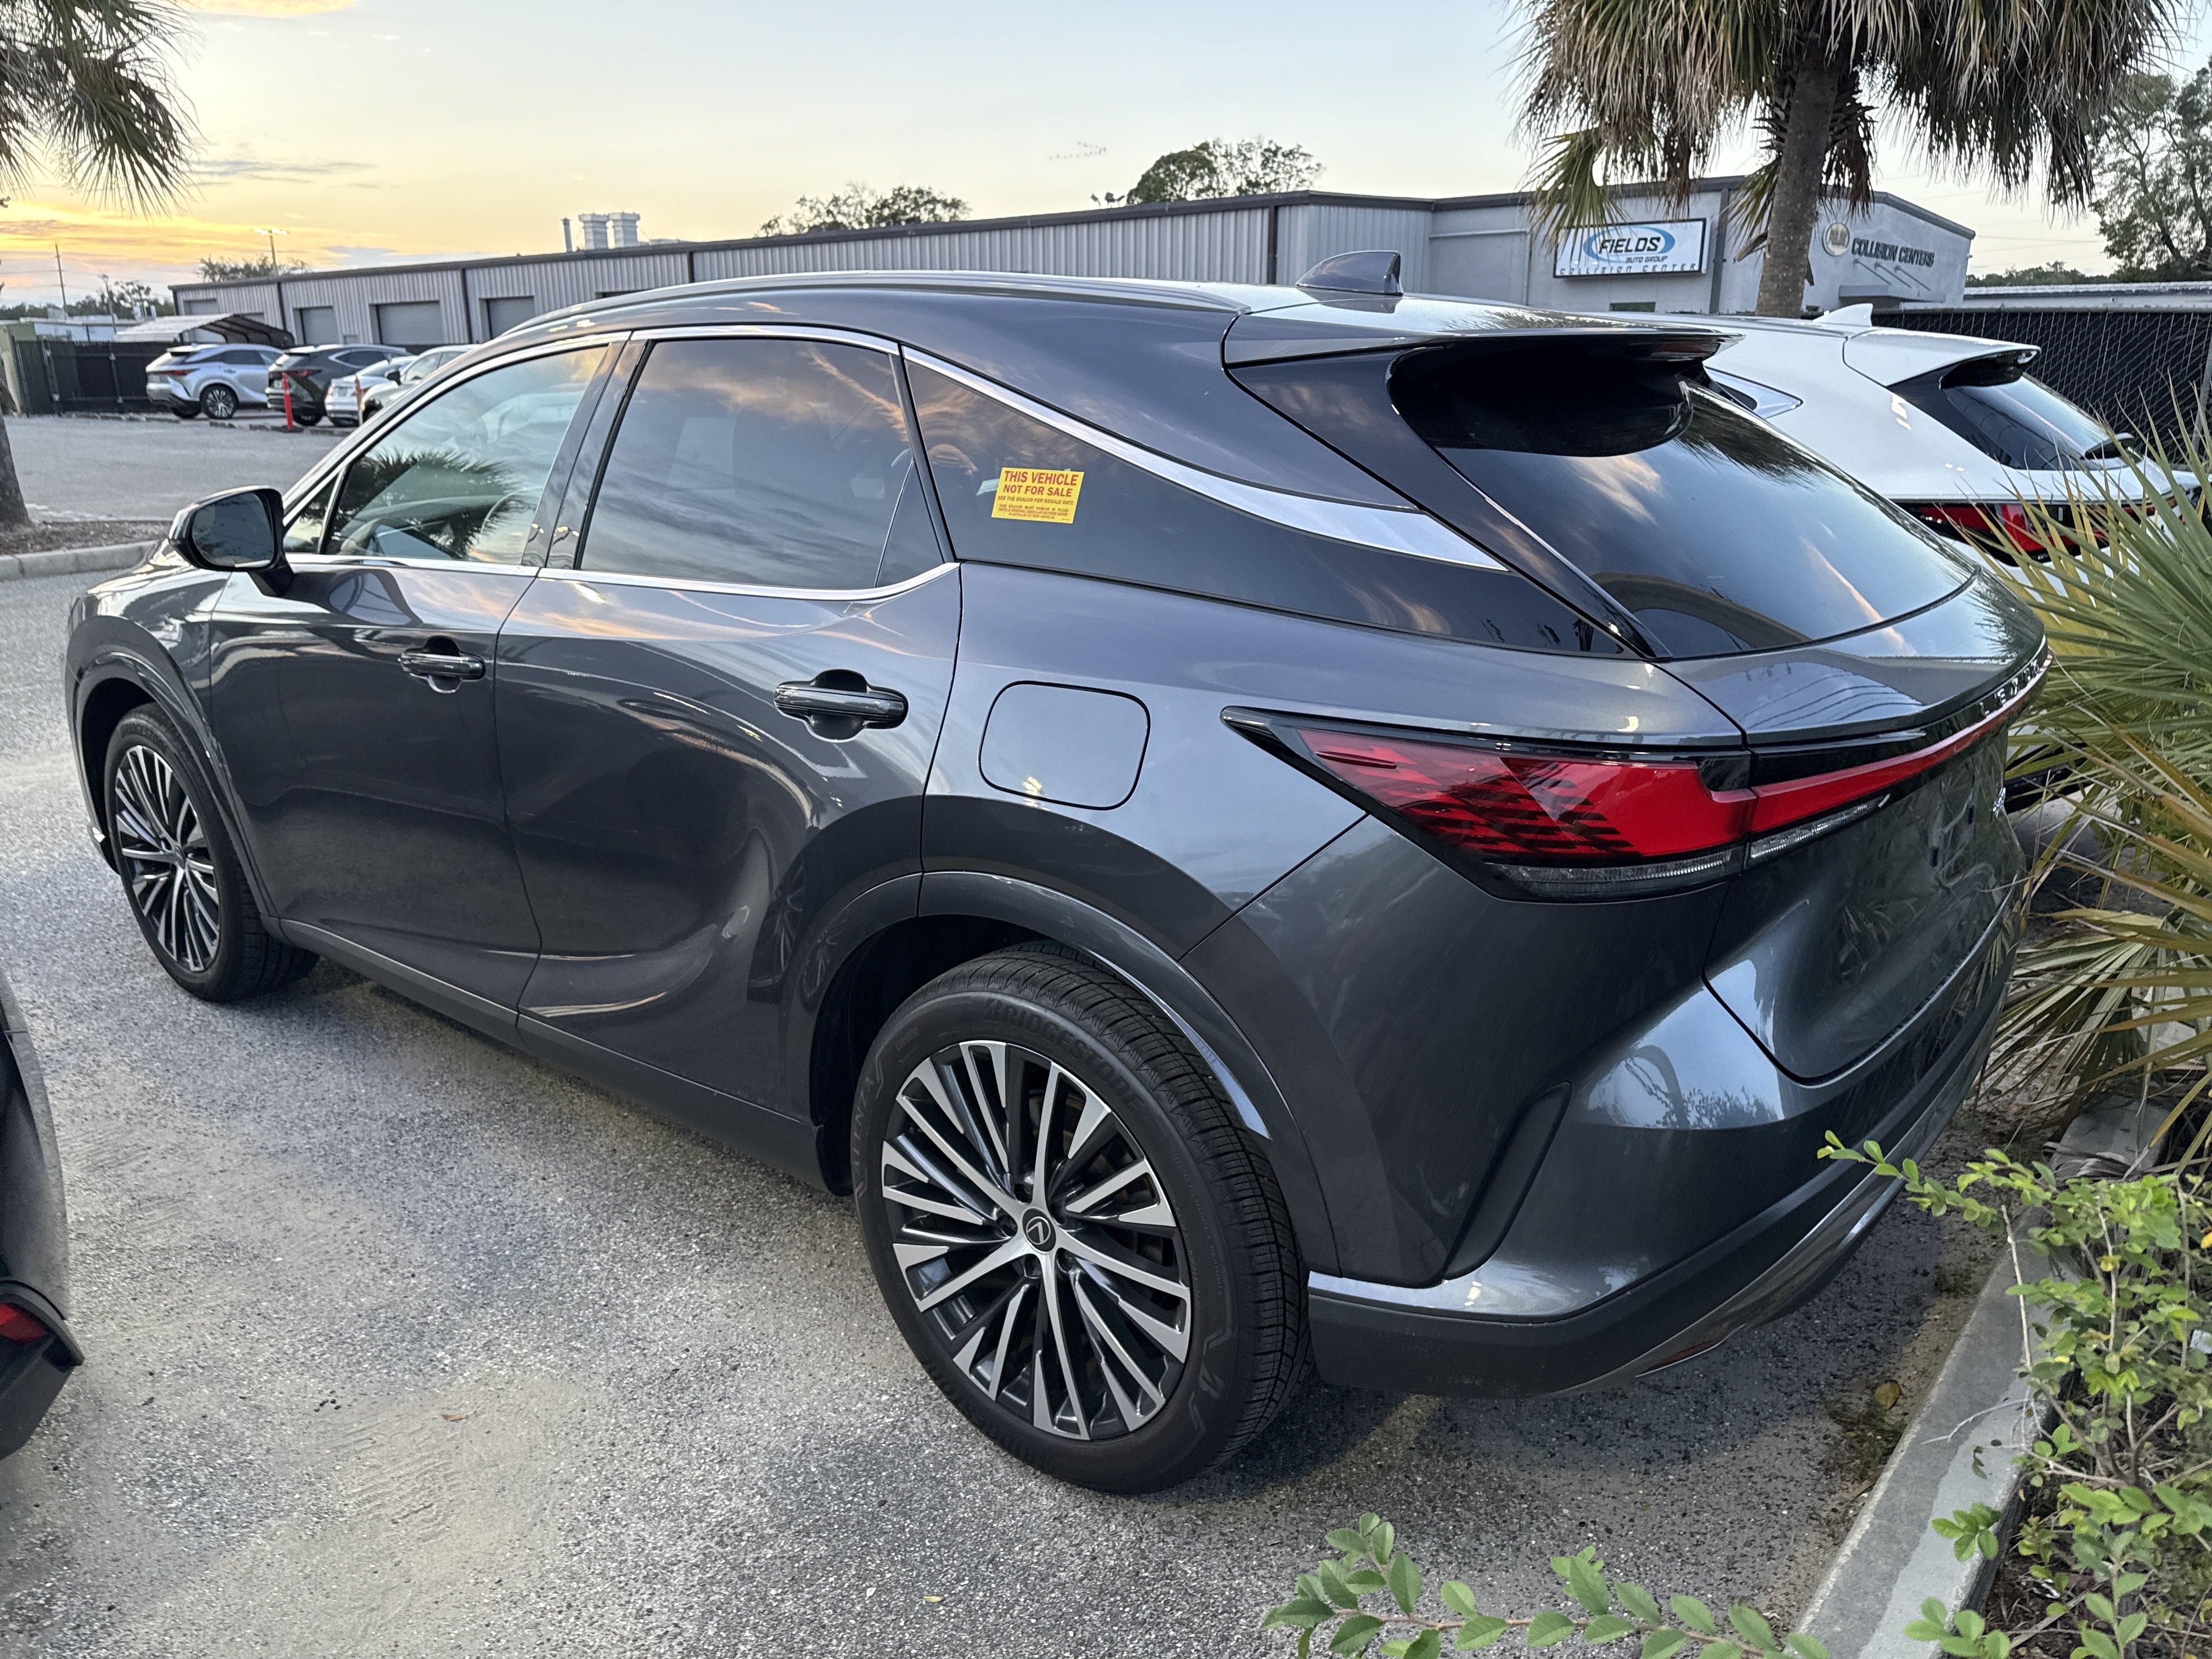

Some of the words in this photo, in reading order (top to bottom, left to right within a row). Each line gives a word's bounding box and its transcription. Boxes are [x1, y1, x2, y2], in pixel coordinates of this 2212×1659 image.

[1598, 236, 1661, 254] FIELDS
[1852, 238, 1898, 262] COLLISION
[1560, 266, 1633, 275] COLLISION
[1642, 263, 1696, 273] CENTER
[1005, 470, 1029, 483] THIS
[1031, 472, 1079, 486] VEHICLE
[1003, 484, 1023, 494] NOT
[1024, 486, 1045, 495] FOR
[1047, 487, 1073, 497] SALE
[983, 998, 1146, 1113] BRIDGESTONE
[851, 1076, 874, 1176] ALENZA
